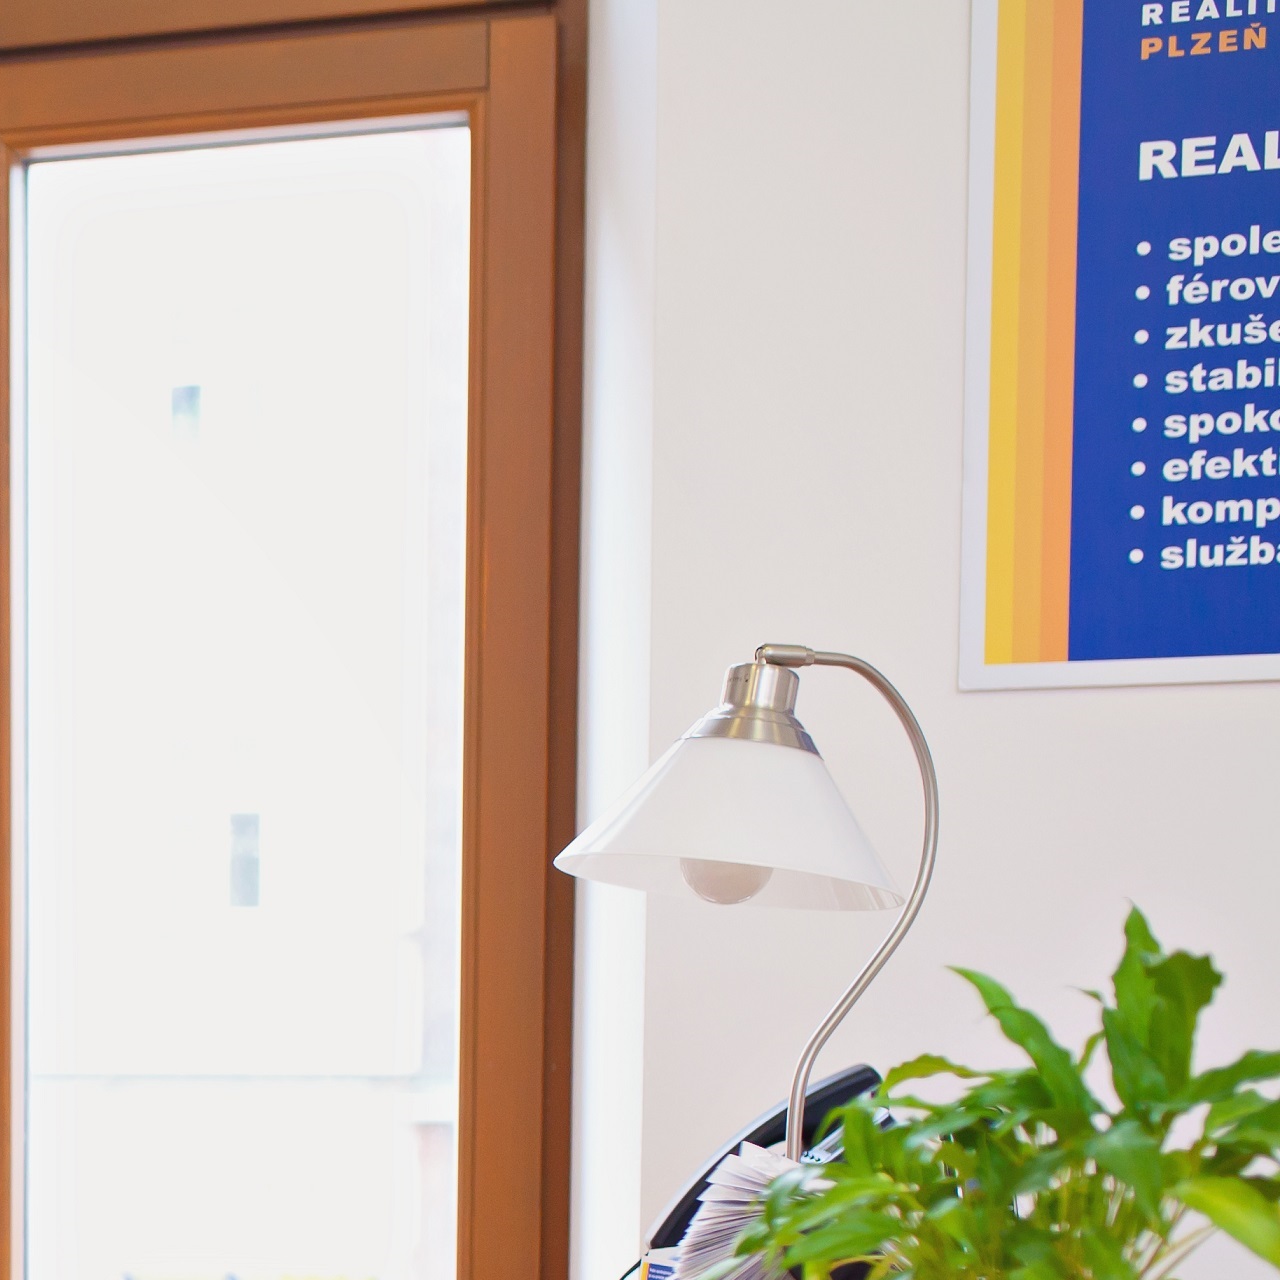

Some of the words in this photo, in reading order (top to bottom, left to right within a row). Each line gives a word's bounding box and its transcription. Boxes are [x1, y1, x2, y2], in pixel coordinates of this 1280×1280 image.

[1140, 21, 1267, 61] PLZEŇ
[1138, 130, 1280, 181] REAL
[1168, 224, 1280, 267] spole
[1166, 272, 1280, 305] férov
[1165, 357, 1280, 394] stabi
[1162, 446, 1280, 482] efekt
[1162, 495, 1280, 528] komp
[1160, 535, 1280, 570] služb
